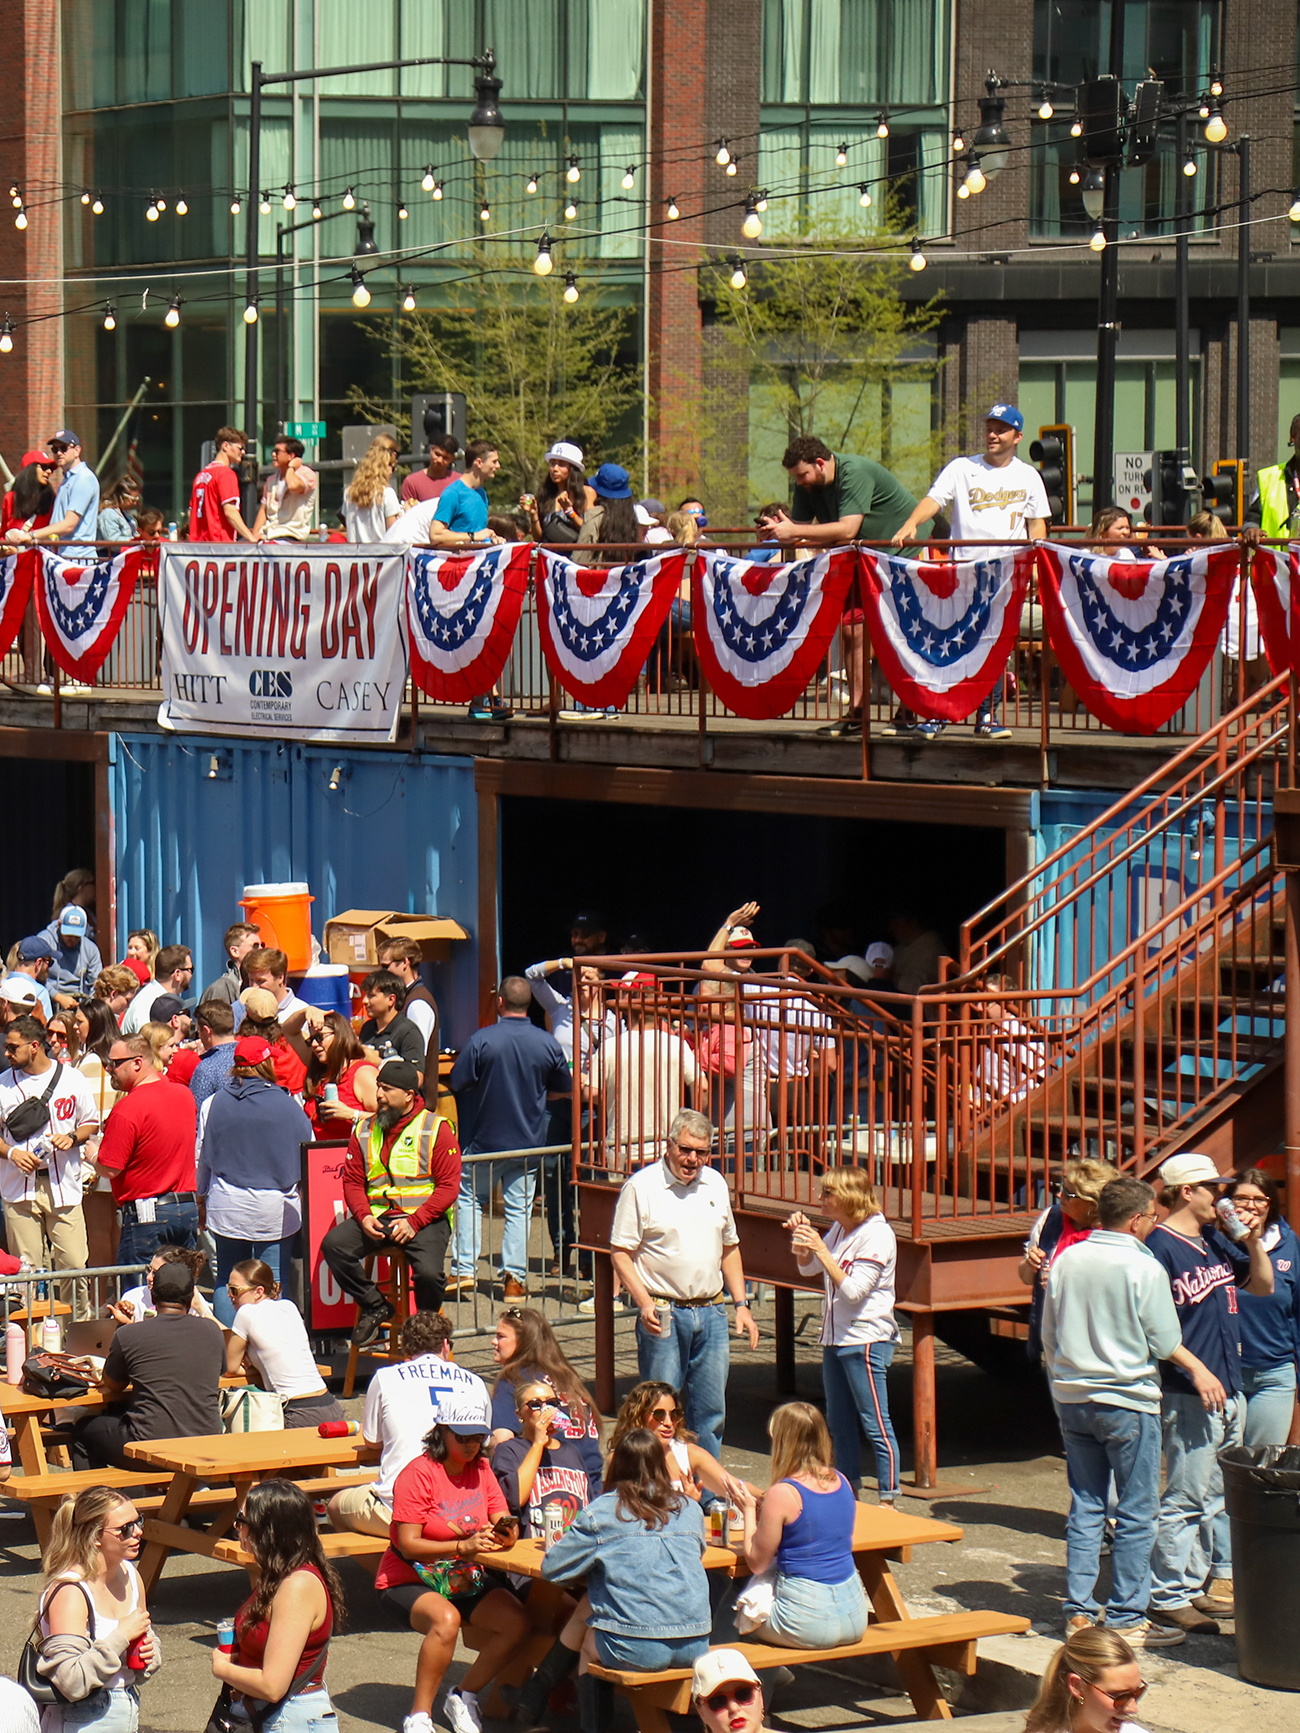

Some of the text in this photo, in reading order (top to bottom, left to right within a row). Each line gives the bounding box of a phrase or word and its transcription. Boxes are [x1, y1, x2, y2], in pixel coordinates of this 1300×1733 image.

[1125, 457, 1142, 468] NO
[1119, 485, 1146, 494] ON RE
[182, 560, 383, 660] OPENING DAY
[174, 673, 227, 704] HITT
[249, 669, 293, 697] CES
[250, 700, 292, 710] CONTEMPORARY
[316, 680, 392, 711] CASEY
[274, 713, 292, 721] SERVICES
[54, 1094, 76, 1121] W
[398, 1364, 473, 1386] FREEMAN
